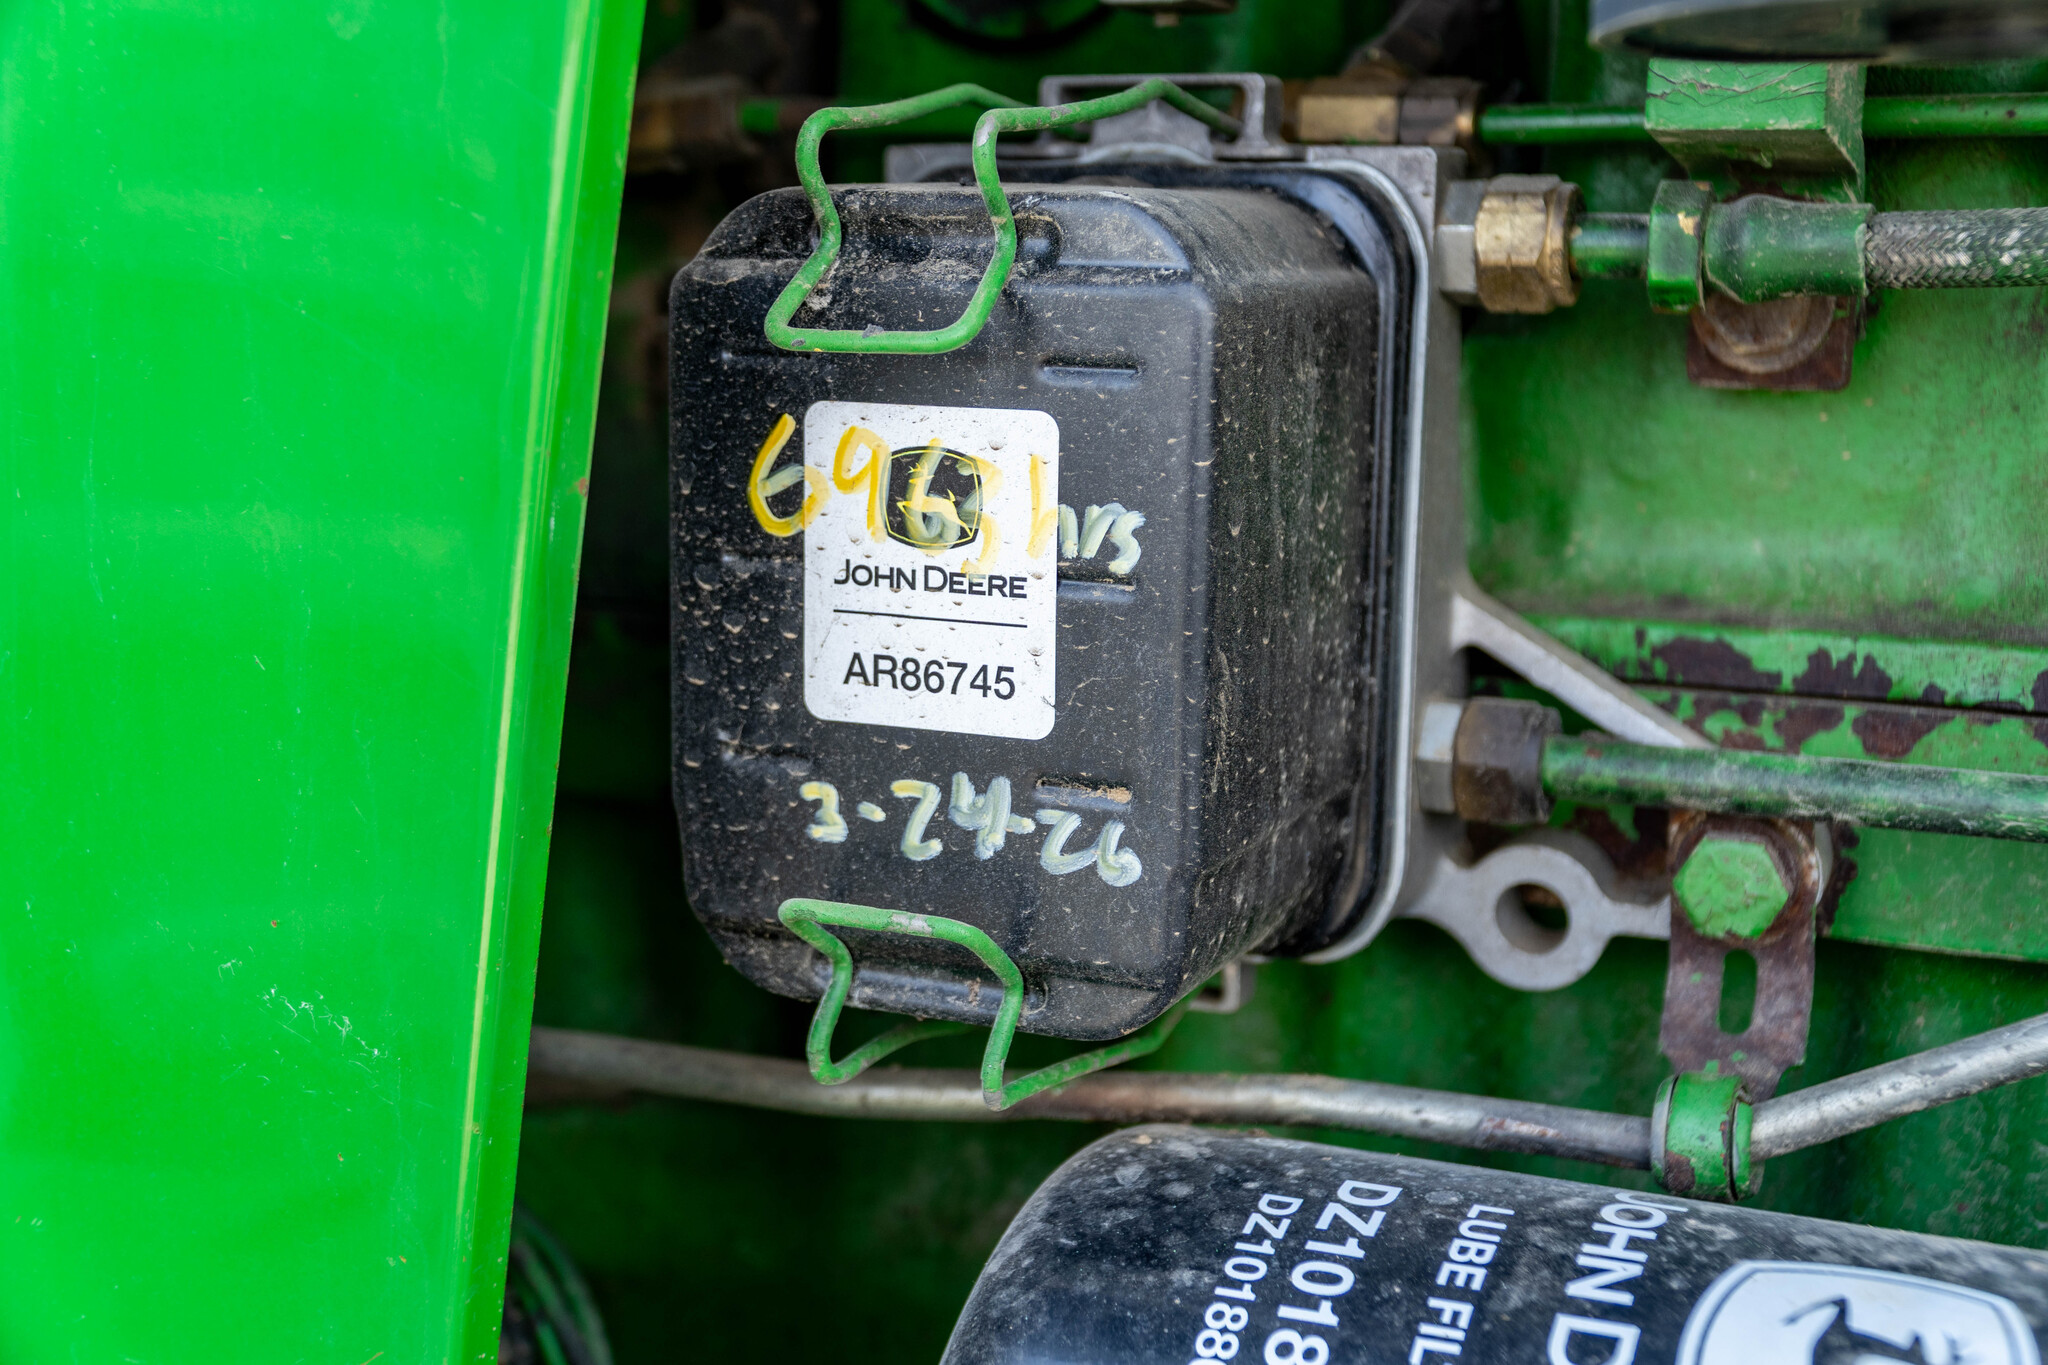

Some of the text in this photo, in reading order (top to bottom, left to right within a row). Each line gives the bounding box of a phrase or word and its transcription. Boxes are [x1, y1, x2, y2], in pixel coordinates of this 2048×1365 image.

[1027, 455, 1146, 574] hrs
[834, 559, 1028, 598] JOHN DEERE
[843, 652, 1016, 700] AR86745
[800, 771, 1142, 887] 3-24-26
[1187, 1193, 1304, 1365] DZ10188
[1409, 1204, 1516, 1365] LUBE FIL
[1564, 1192, 1689, 1307] JOHN
